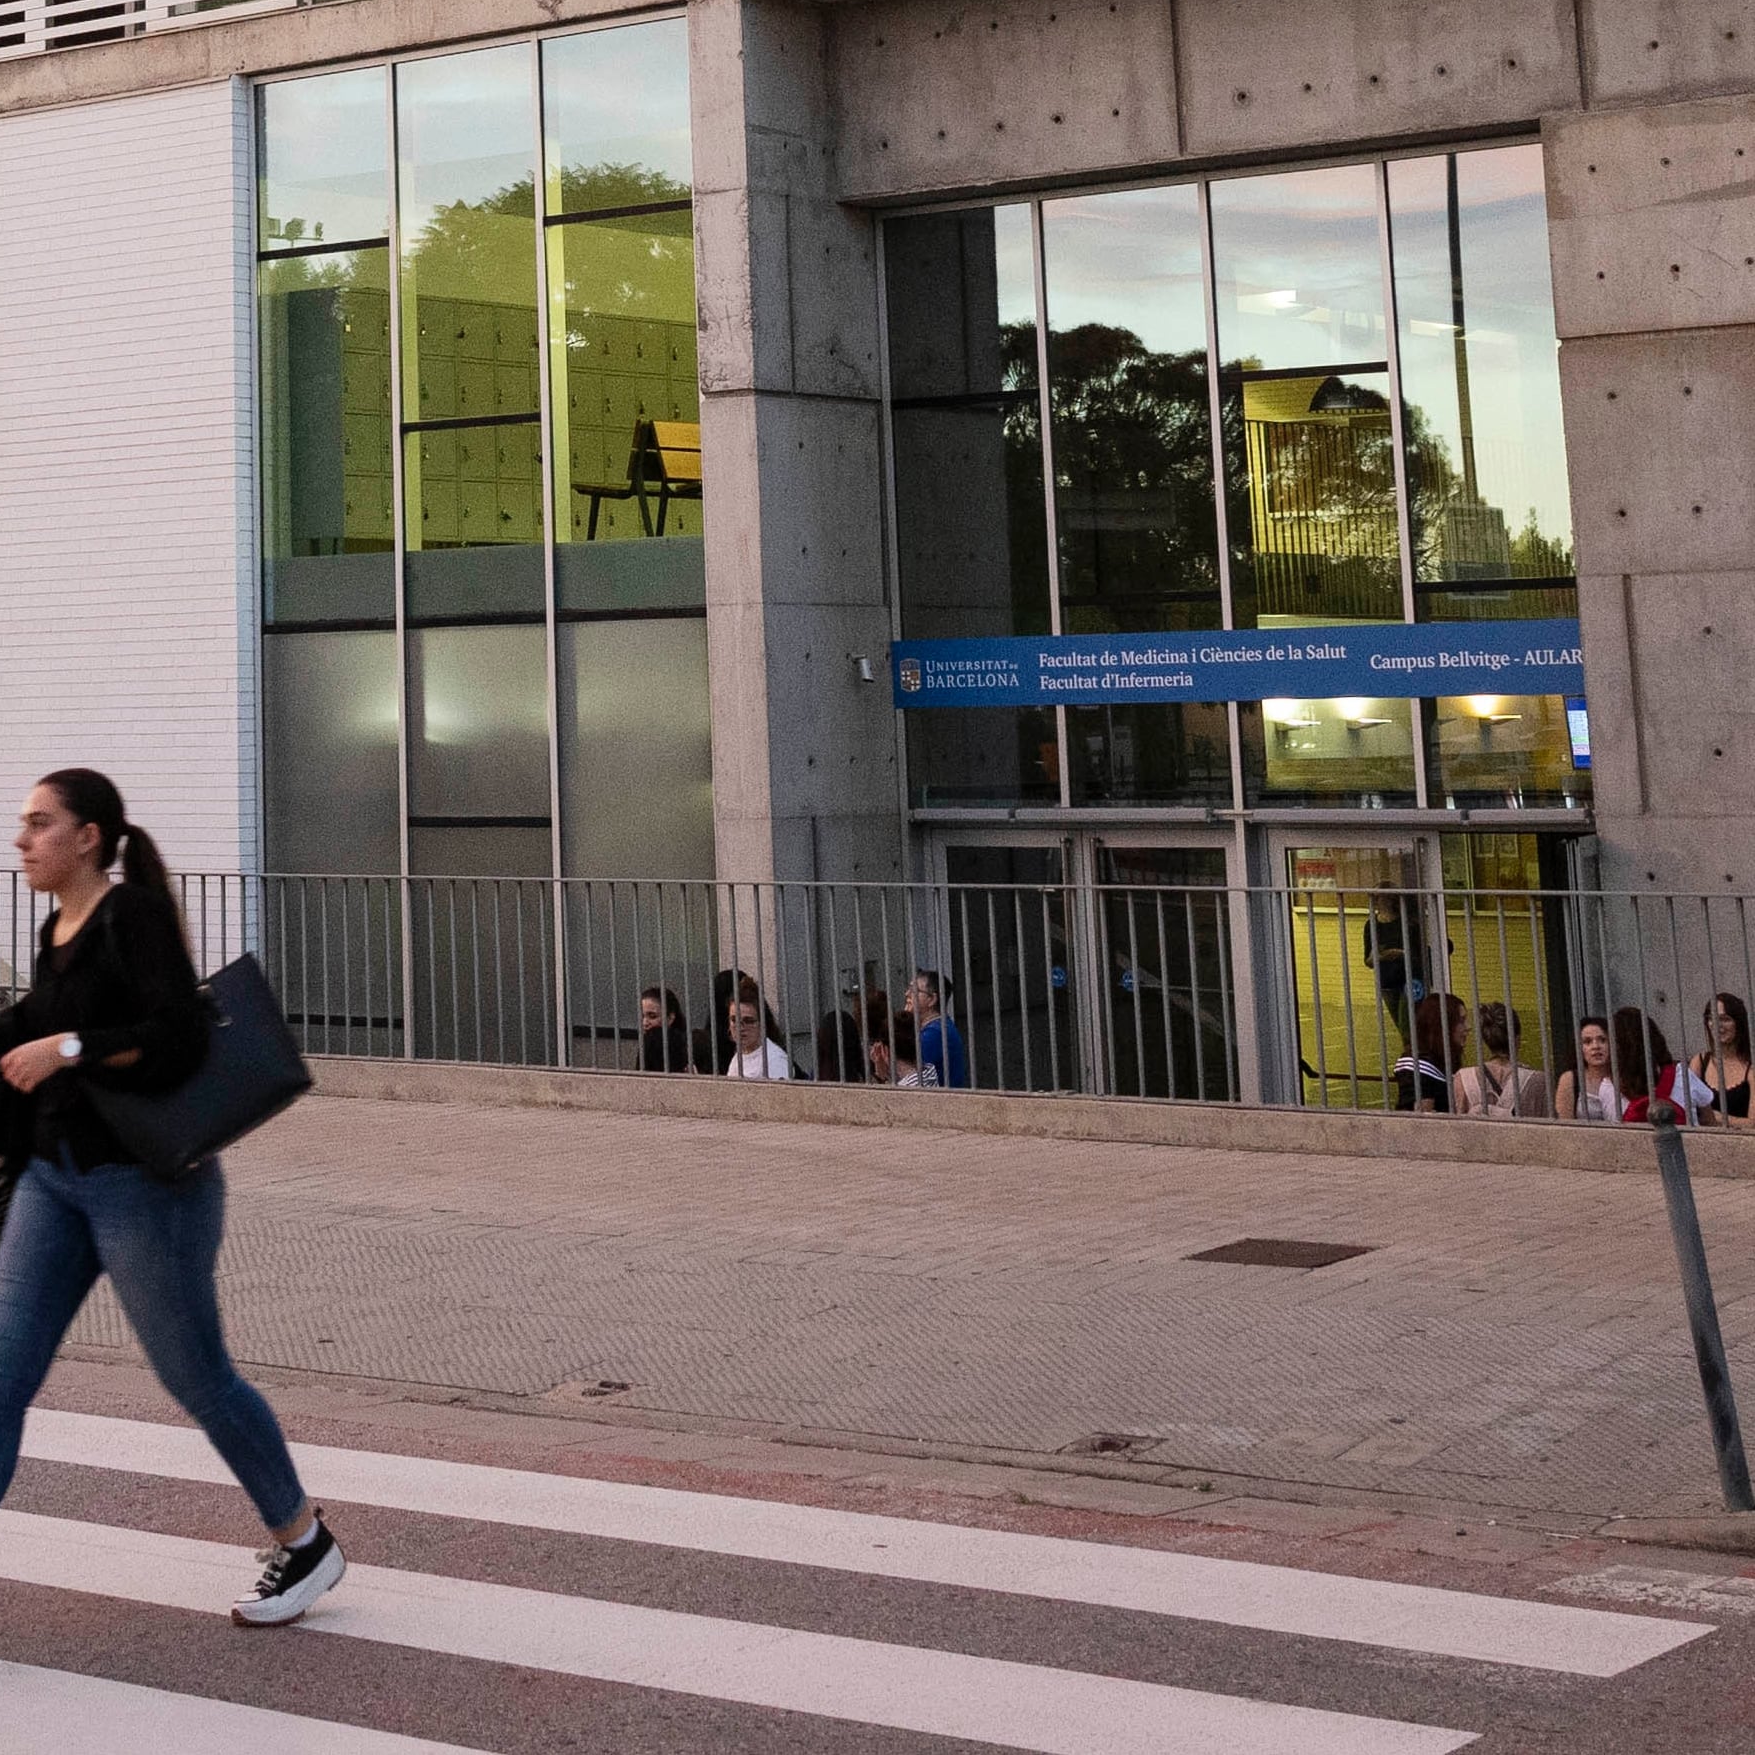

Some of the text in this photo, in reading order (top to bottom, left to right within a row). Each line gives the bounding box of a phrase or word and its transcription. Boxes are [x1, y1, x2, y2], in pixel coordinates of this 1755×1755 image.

[925, 659, 1009, 674] UNIVERSITAT
[1038, 643, 1348, 669] Facultat de Medicina i Ciències de la Salut
[1369, 653, 1435, 673] Campus
[1439, 650, 1510, 672] Bellvitge
[926, 673, 1020, 689] BARCELONA
[1039, 670, 1194, 691] Facultat d'Infermeria
